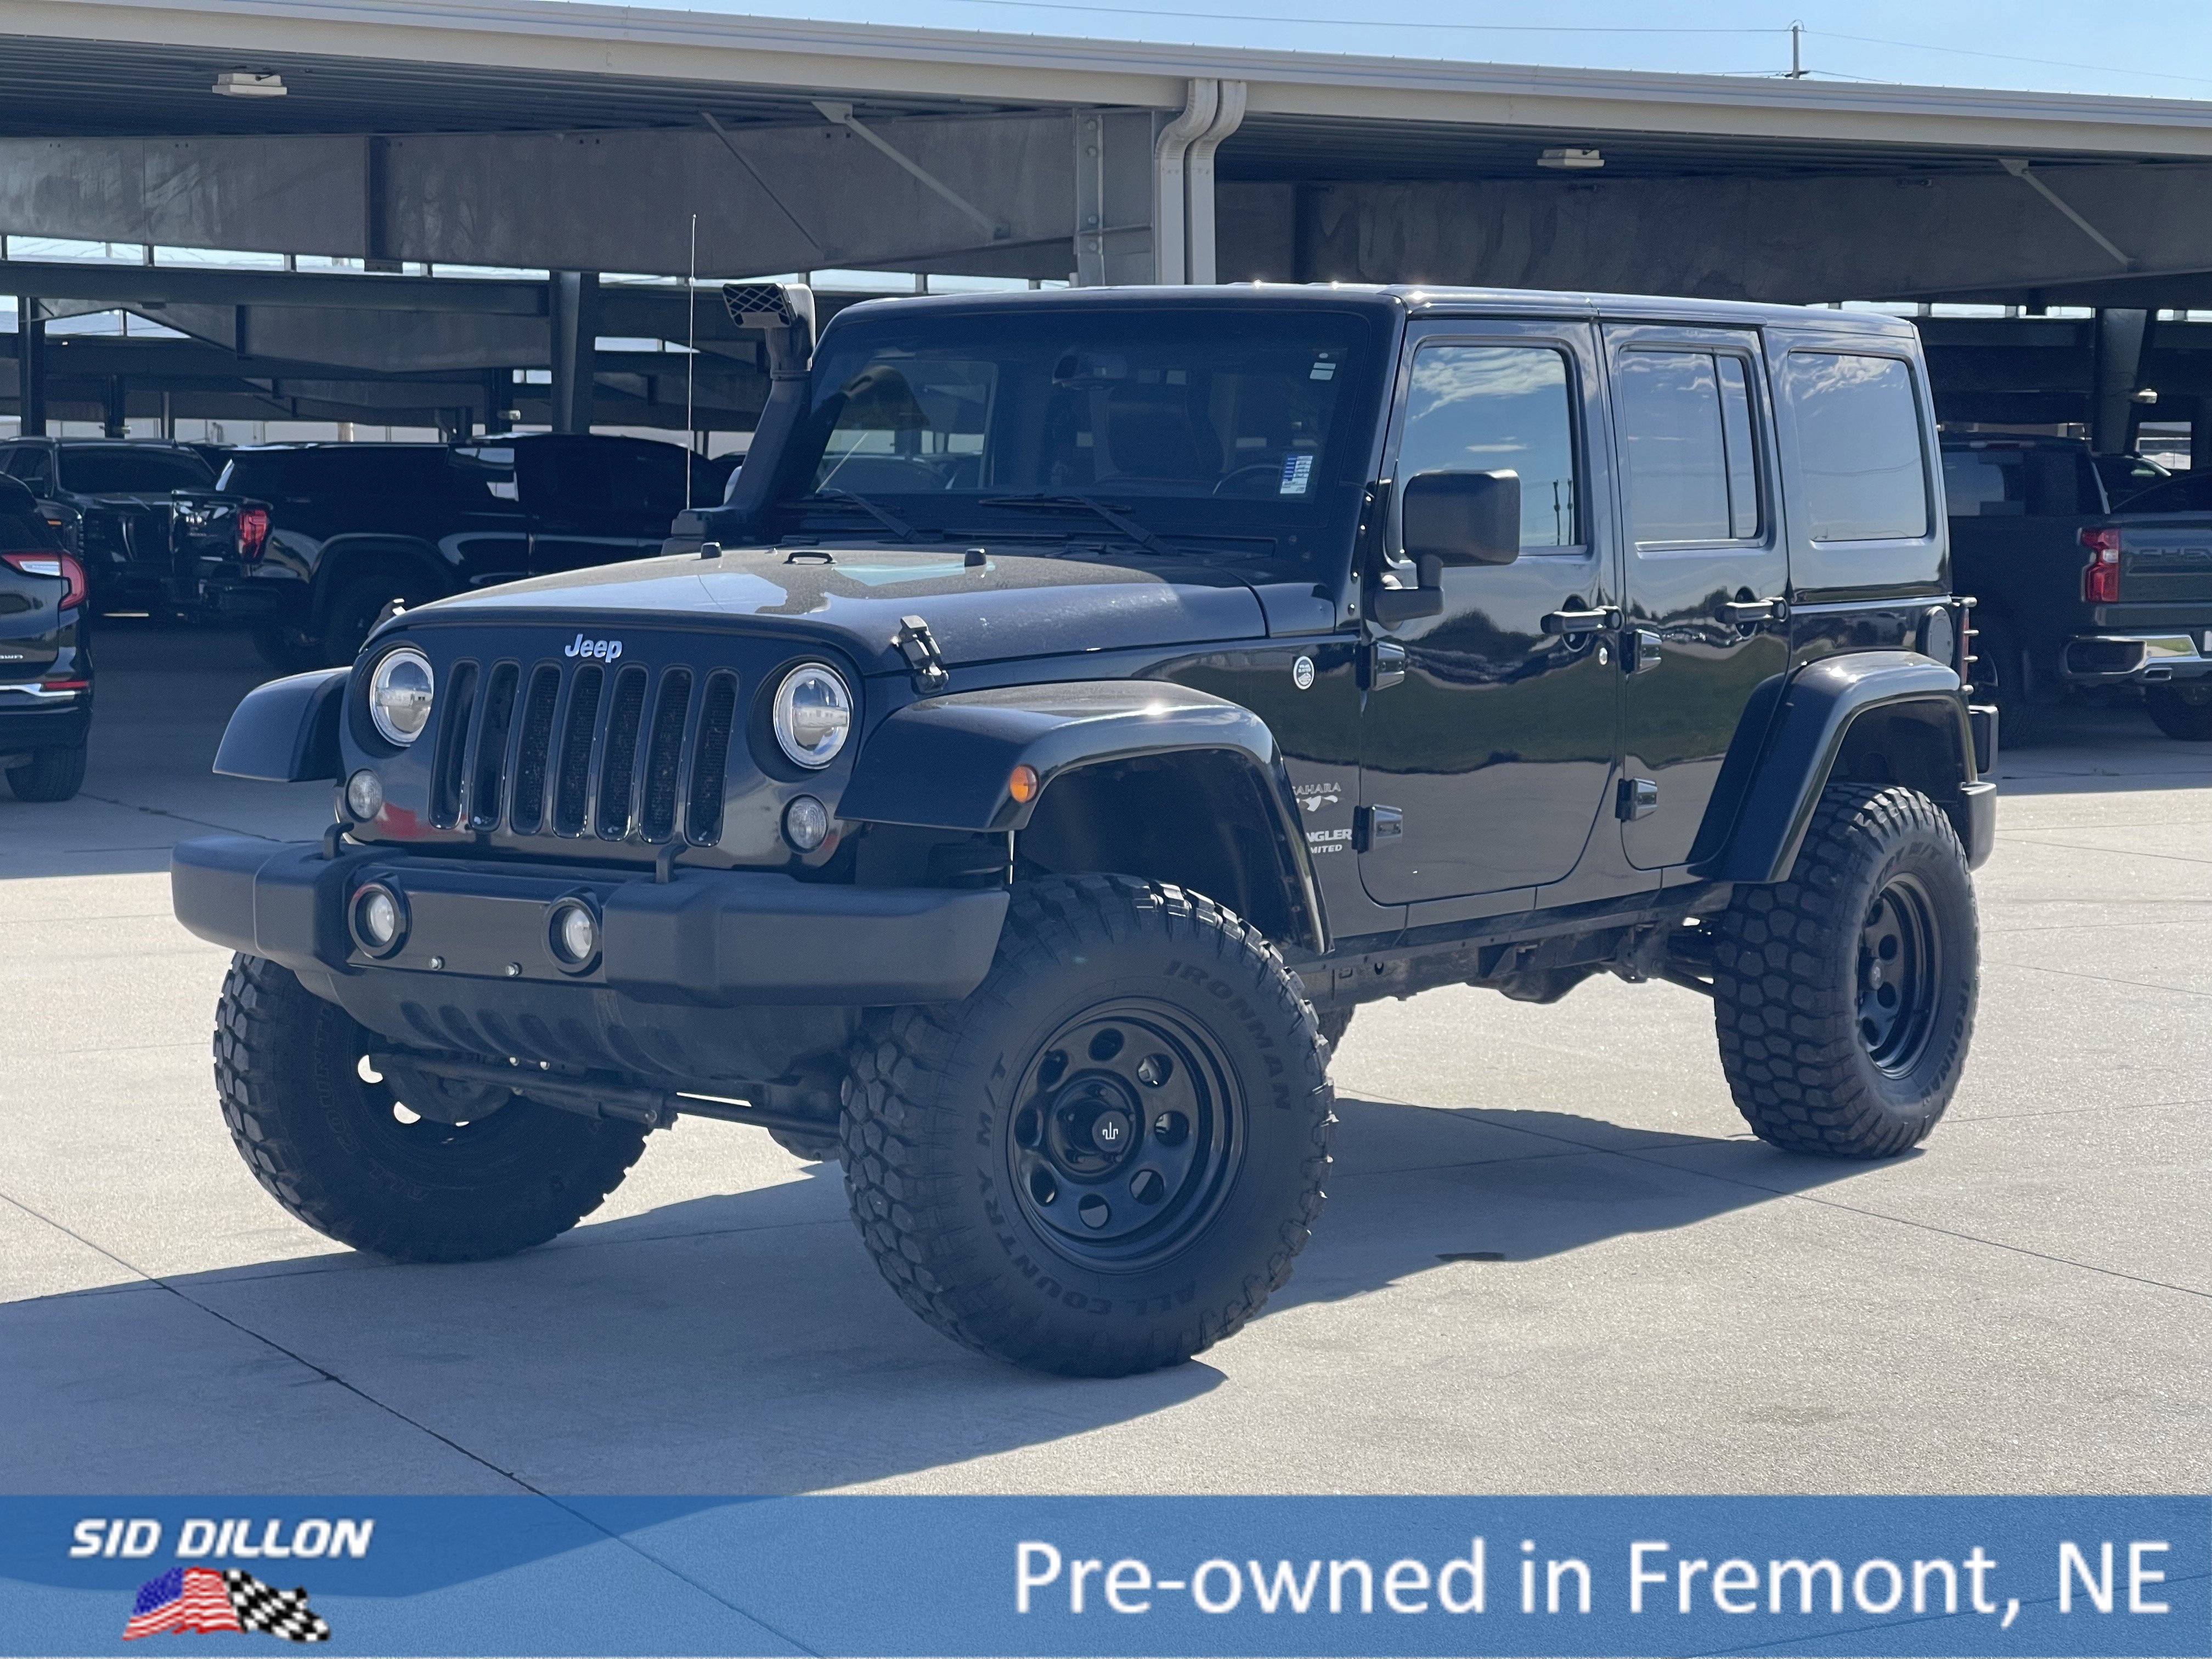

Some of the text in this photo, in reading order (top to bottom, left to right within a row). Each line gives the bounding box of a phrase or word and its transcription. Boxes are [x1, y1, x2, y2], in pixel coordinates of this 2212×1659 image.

[565, 633, 623, 663] Jeep
[1164, 961, 1290, 1110] IRONMAN
[975, 1052, 1007, 1148] M/T
[977, 1165, 1113, 1316] COUNTRY
